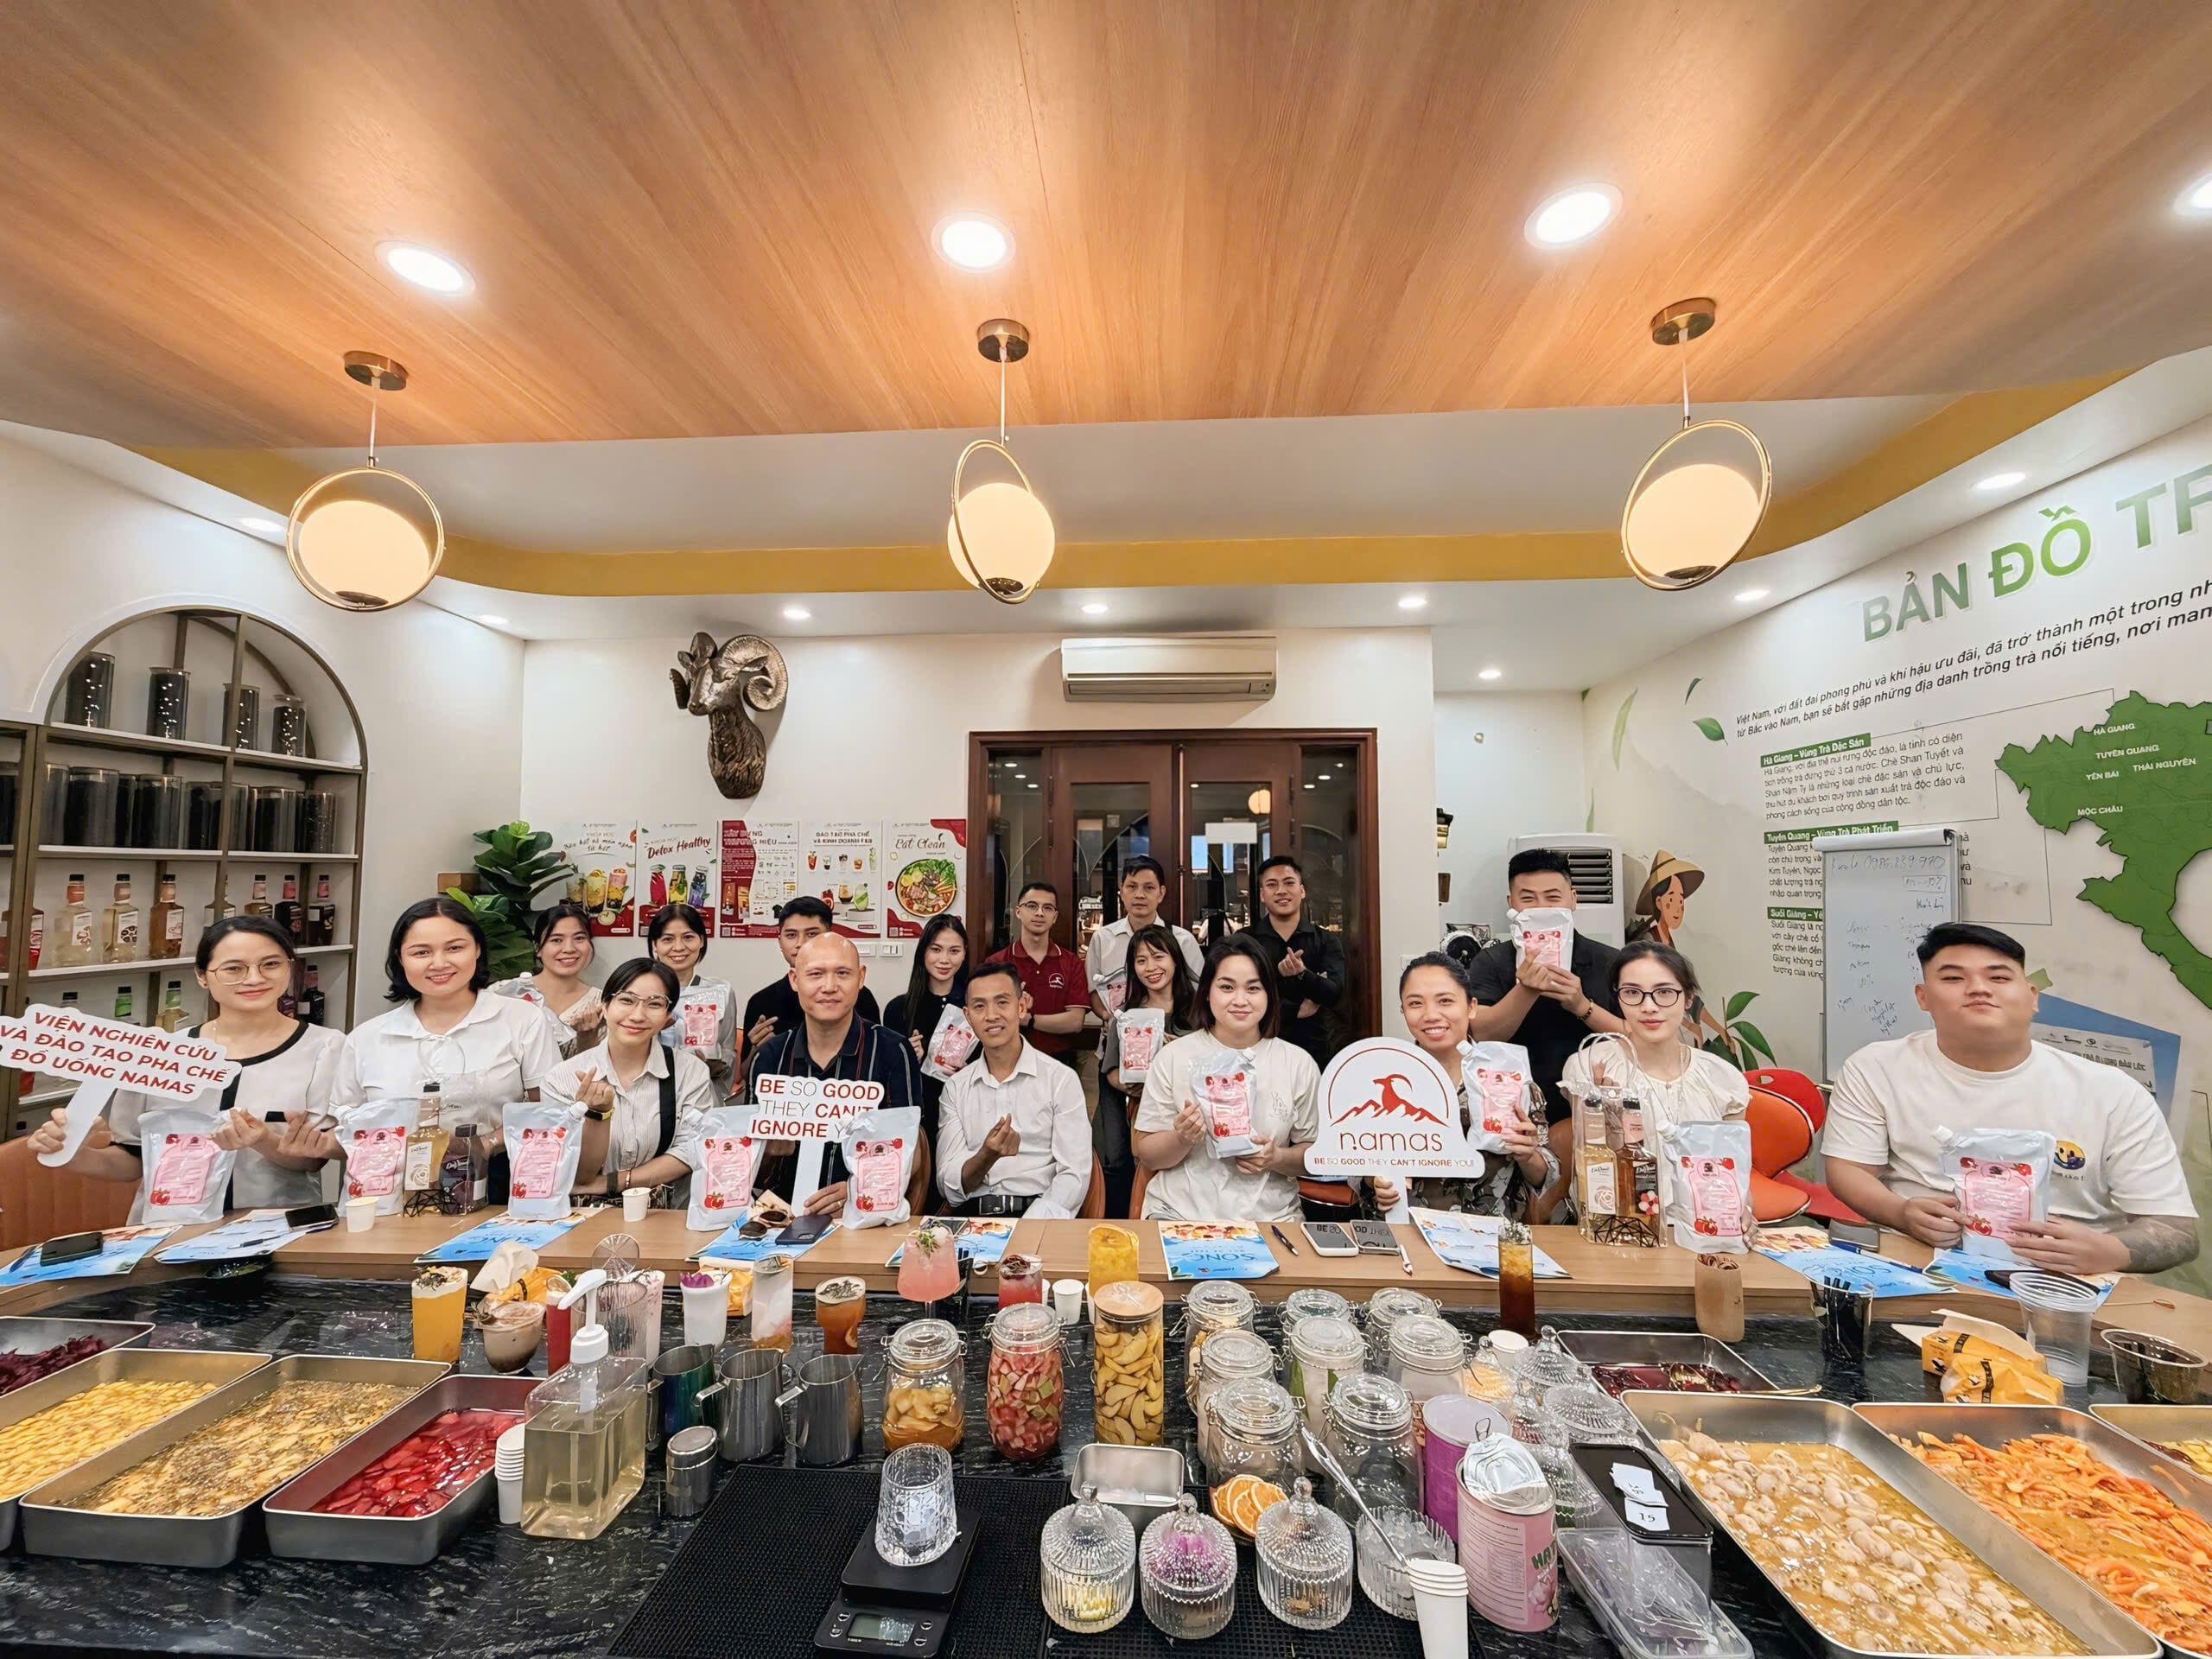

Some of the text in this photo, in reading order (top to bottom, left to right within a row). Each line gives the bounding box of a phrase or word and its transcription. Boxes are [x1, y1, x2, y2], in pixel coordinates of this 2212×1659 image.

[1862, 467, 2212, 642] BẢN ĐỒ TR
[1736, 591, 2183, 725] Việt Nam, với đất đai phong phú và khí hậu ưu đãi, đã trở thành một trong
[1737, 606, 2212, 738] từ Bắc vào Nam, bạn sẽ bắt gặp những địa danh trồng trà nổi tiếng, nơi man
[2094, 722, 2136, 736] HÀ GIANG
[1773, 754, 1793, 764] Giang
[1900, 753, 1923, 765] Shan
[1924, 747, 1950, 761] Tuyết
[2095, 744, 2159, 760] TUYÊN QUANG
[2133, 757, 2196, 772] THÁI NGUYÊN
[2086, 770, 2120, 781] YÊN BÁI
[2077, 805, 2123, 817] MỘC CHÂU
[647, 844, 673, 859] Detox
[677, 836, 711, 853] Healthy
[895, 837, 945, 849] Eat Clean
[35, 1012, 217, 1061] VIỆN NGHIÊN CỨU
[0, 1024, 232, 1083] VÀ ĐÀO TẠO PHA CHẾ
[10, 1048, 195, 1095] ĐỒ UỐNG NAMAS
[760, 1078, 880, 1100] BE SO GOOD
[762, 1099, 810, 1117] THEY
[751, 1119, 829, 1138] IGNORE
[1339, 1132, 1443, 1152] namas
[1639, 1513, 1656, 1522] 15
